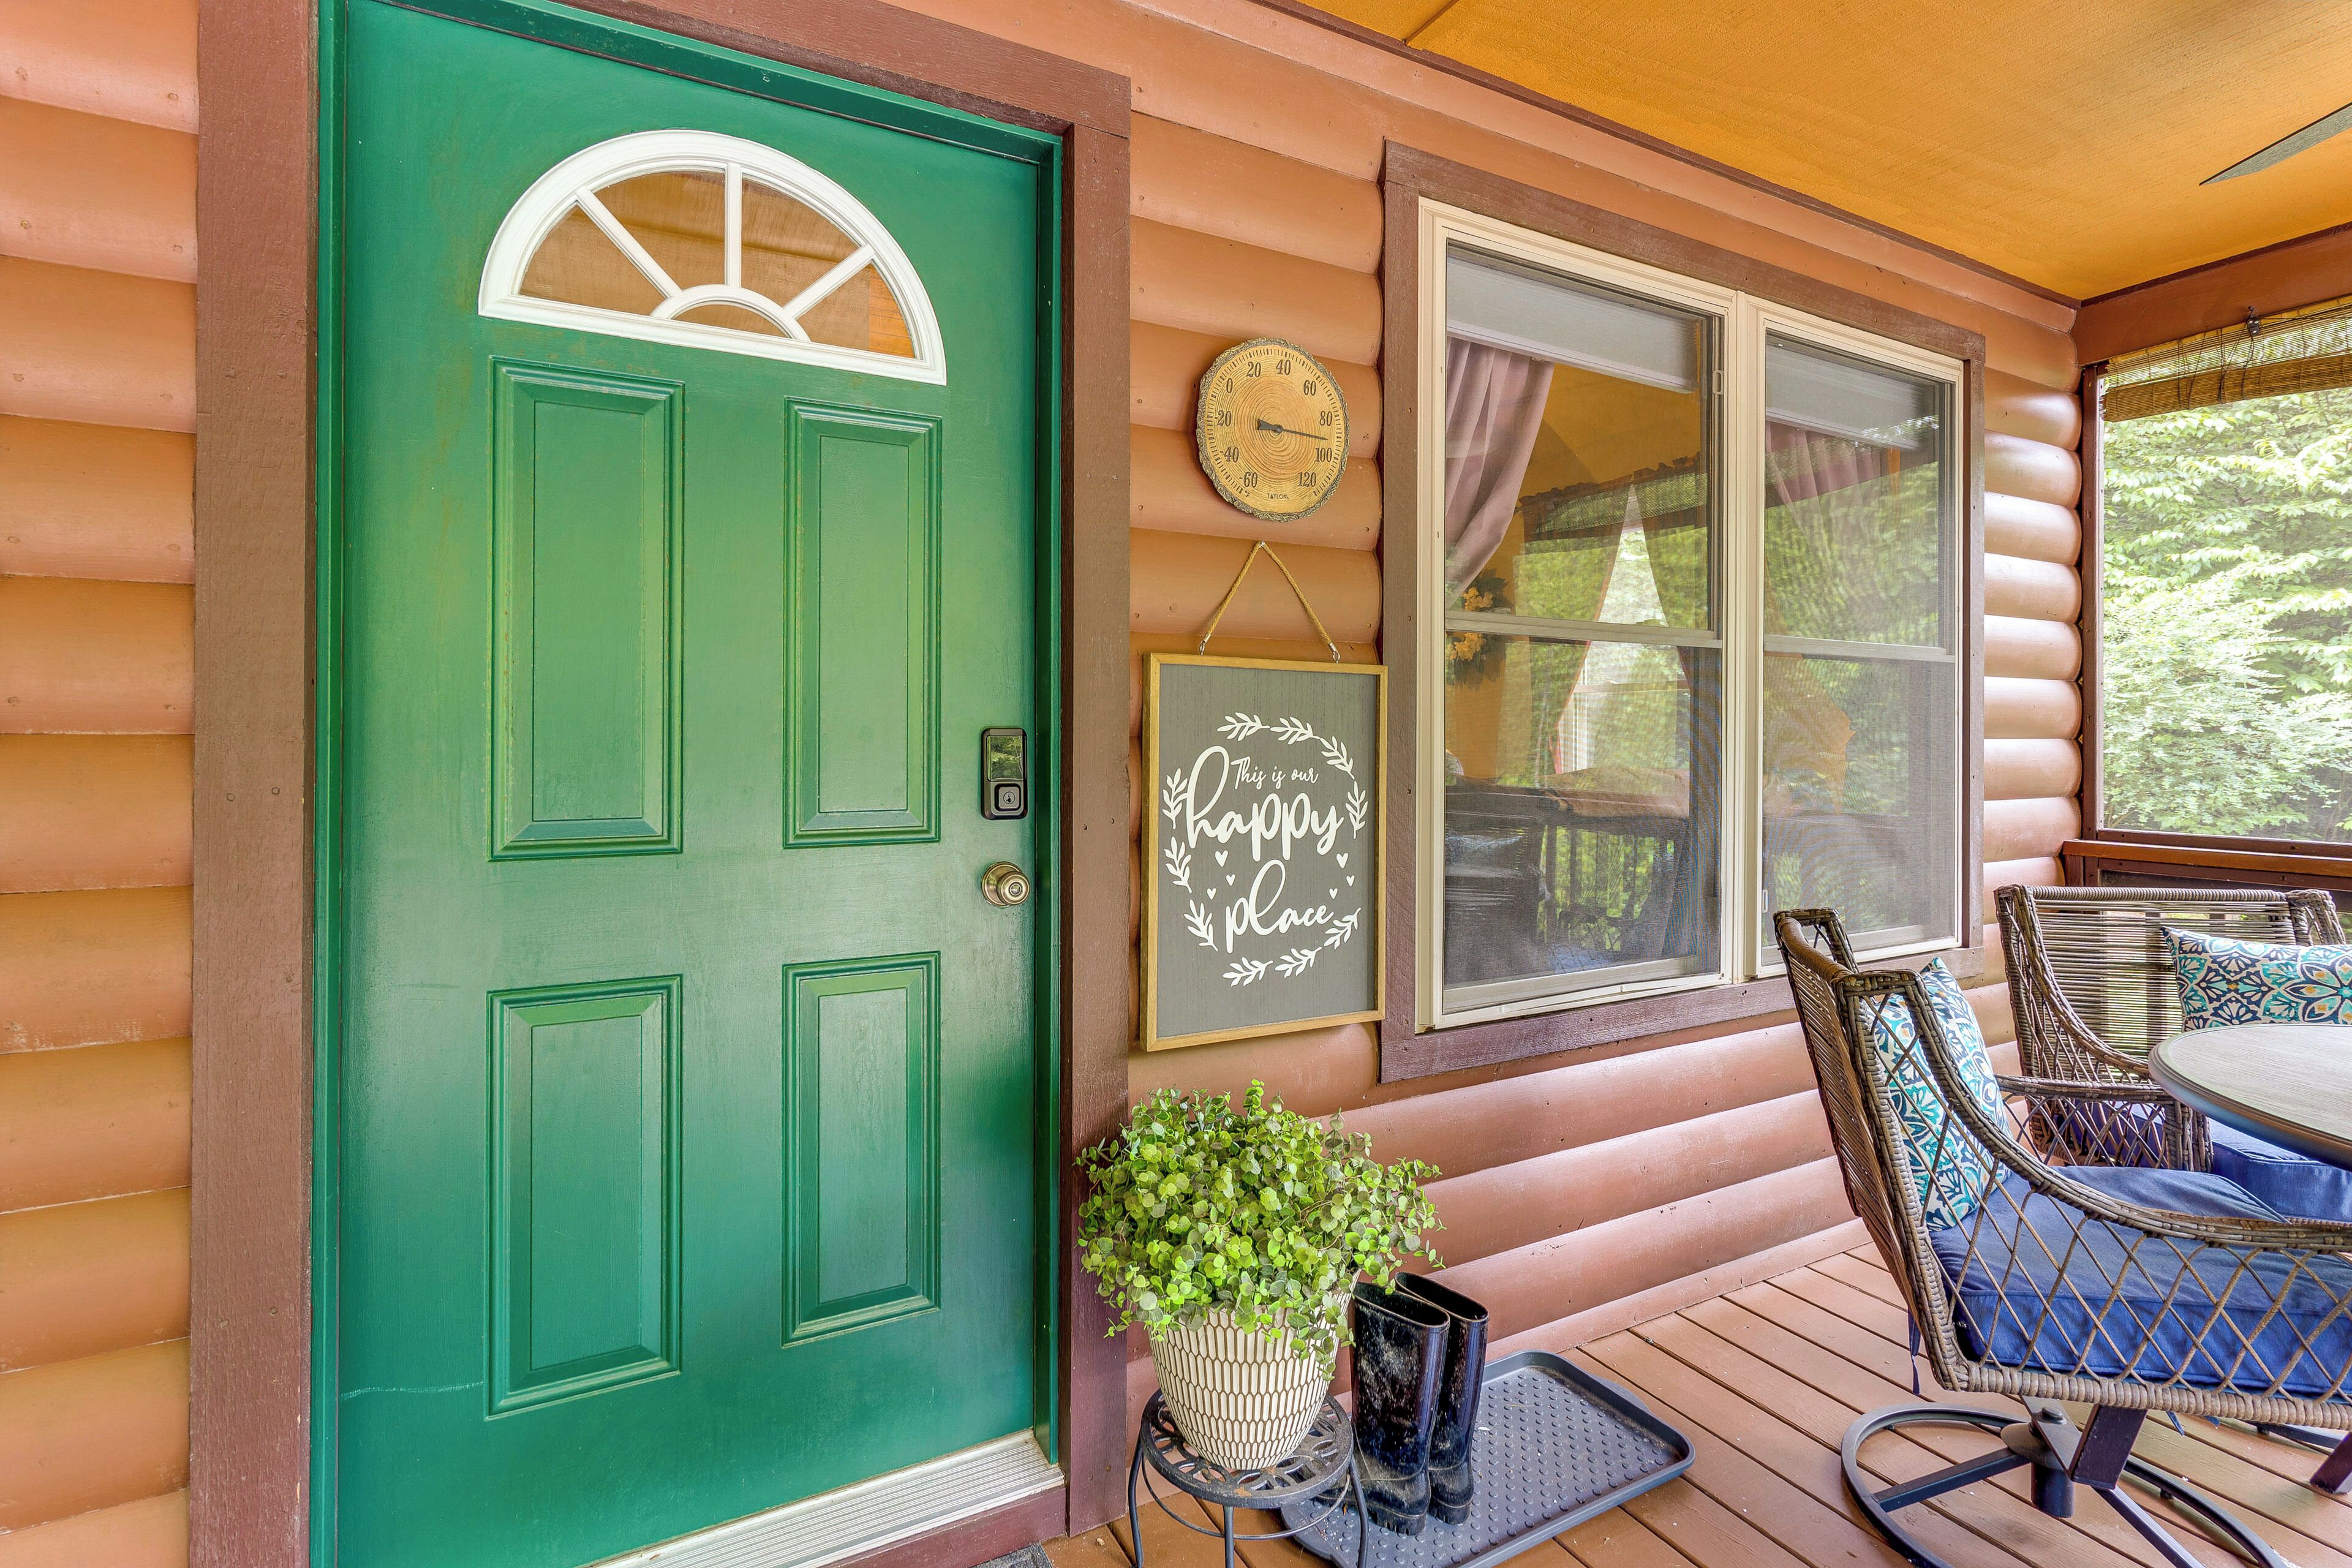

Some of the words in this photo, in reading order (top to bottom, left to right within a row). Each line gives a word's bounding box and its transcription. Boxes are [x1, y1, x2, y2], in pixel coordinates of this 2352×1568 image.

[1246, 361, 1262, 378] 20
[1276, 359, 1291, 375] 40
[1226, 378, 1234, 394] 0
[1303, 380, 1316, 396] 60
[1319, 411, 1333, 426] 80
[1314, 447, 1332, 462] 100
[1298, 472, 1317, 487] 120
[1230, 756, 1267, 790] This
[1272, 765, 1286, 790] is
[1291, 767, 1319, 783] our
[1186, 745, 1344, 862] happy
[1226, 859, 1334, 954] place
